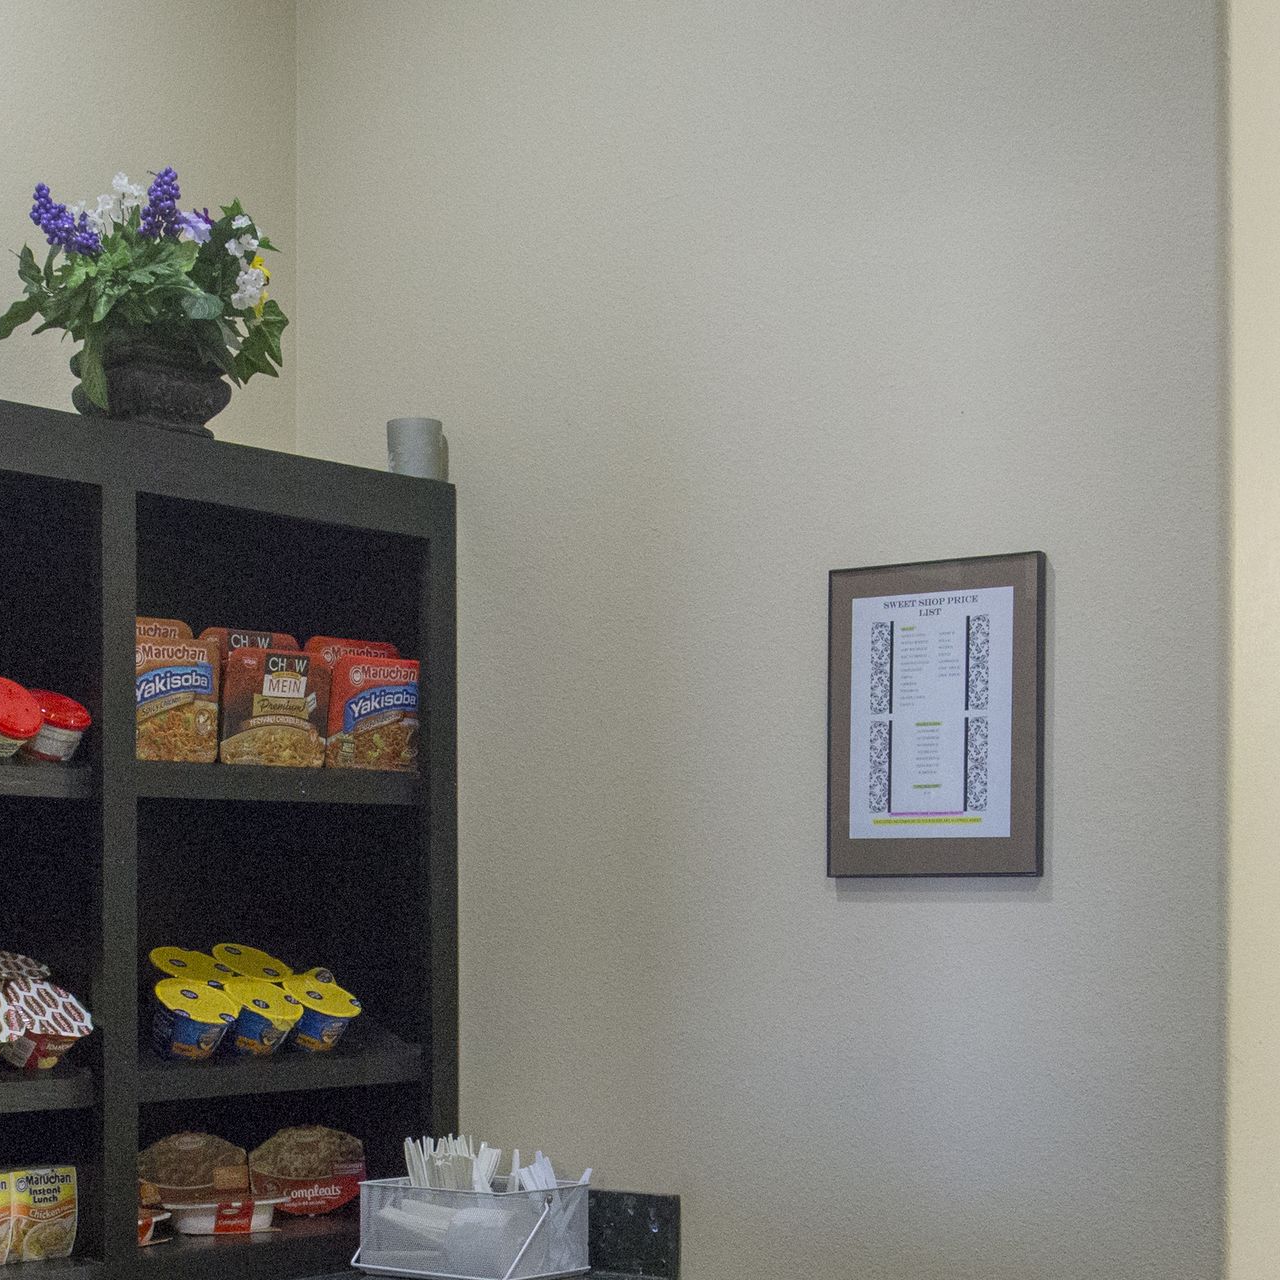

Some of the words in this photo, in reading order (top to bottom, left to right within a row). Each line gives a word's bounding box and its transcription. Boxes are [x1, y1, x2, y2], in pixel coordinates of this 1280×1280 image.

[883, 599, 916, 609] SWEET
[918, 598, 946, 607] SHOP
[947, 595, 978, 604] PRICE
[919, 608, 942, 617] LIST
[136, 625, 177, 639] ruchan
[142, 645, 206, 661] Maruchan
[361, 666, 417, 680] Maruchan
[269, 679, 301, 693] MEIN
[350, 692, 417, 718] Yakisoba
[27, 1173, 72, 1187] Maruchan
[29, 1185, 62, 1197] Instant
[32, 1194, 59, 1204] Lunch
[29, 1206, 60, 1219] Chicken
